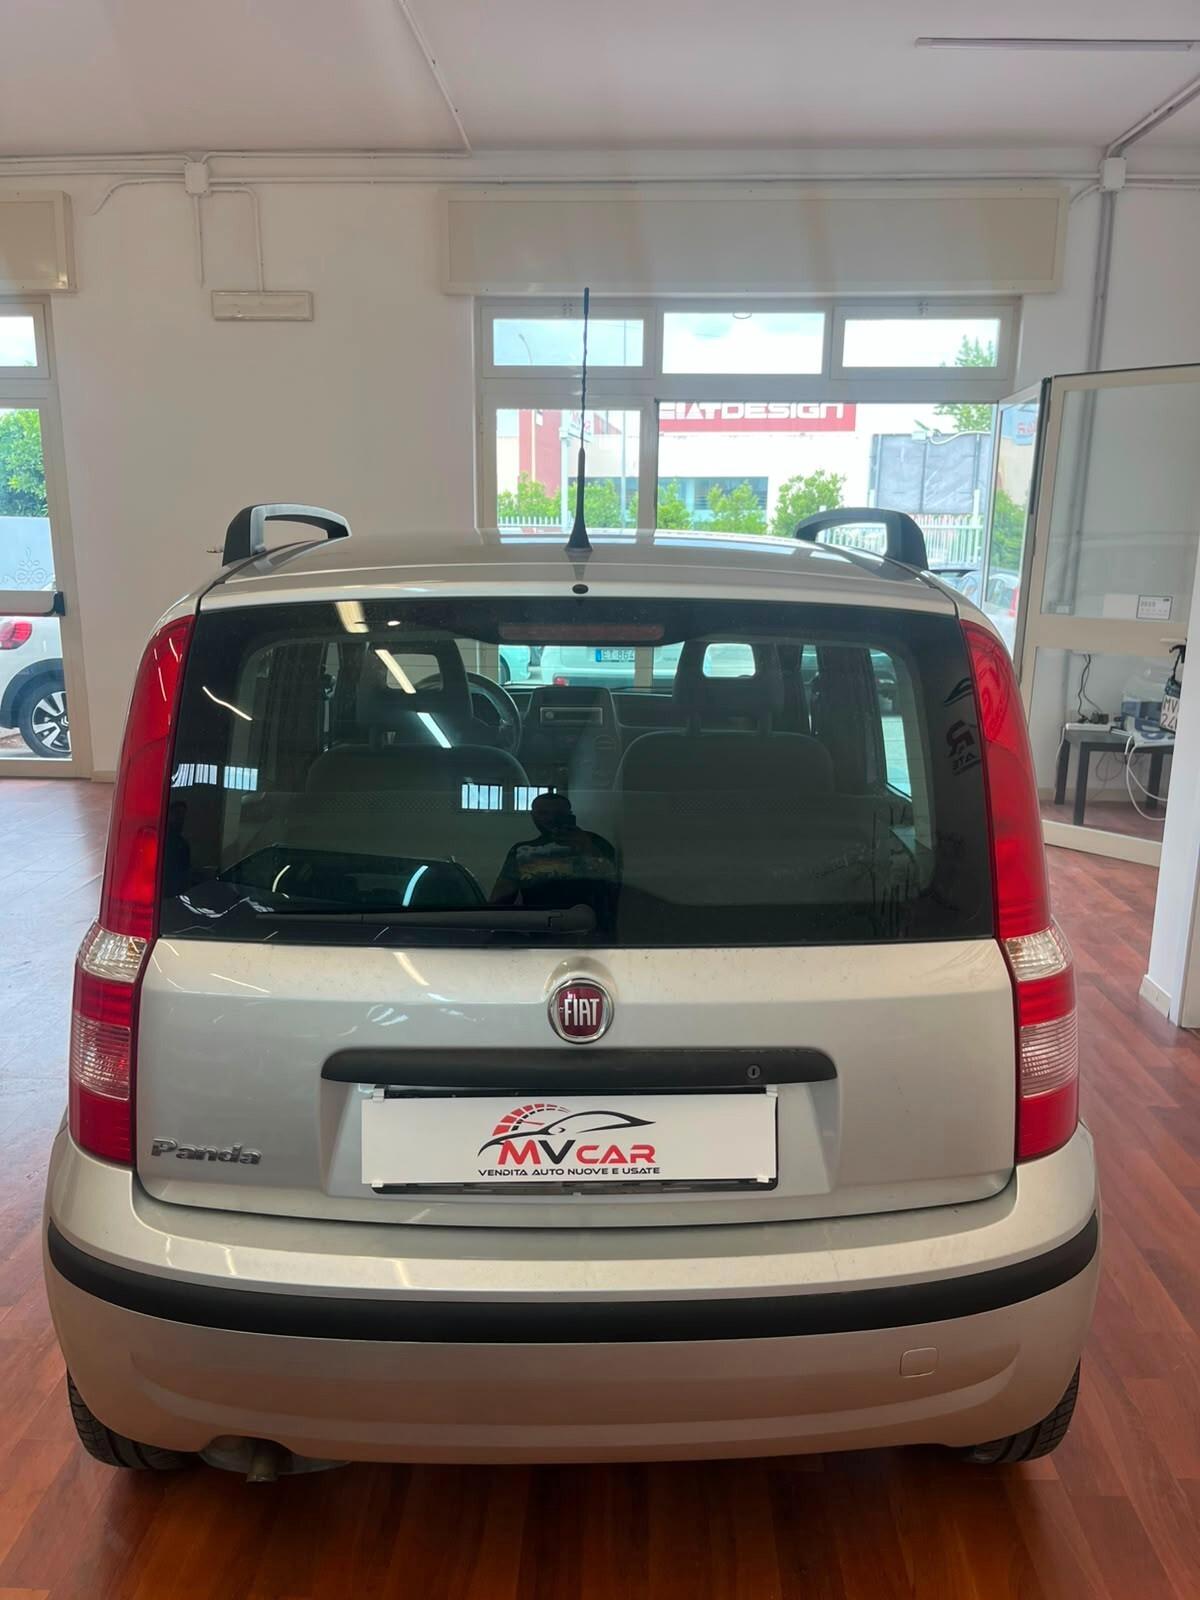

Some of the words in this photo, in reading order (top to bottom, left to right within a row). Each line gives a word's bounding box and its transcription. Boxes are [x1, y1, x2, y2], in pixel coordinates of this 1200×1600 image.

[564, 998, 600, 1026] FIAT
[151, 1137, 262, 1165] Panda
[478, 1169, 528, 1177] VENDITA
[531, 1168, 565, 1176] AUTO
